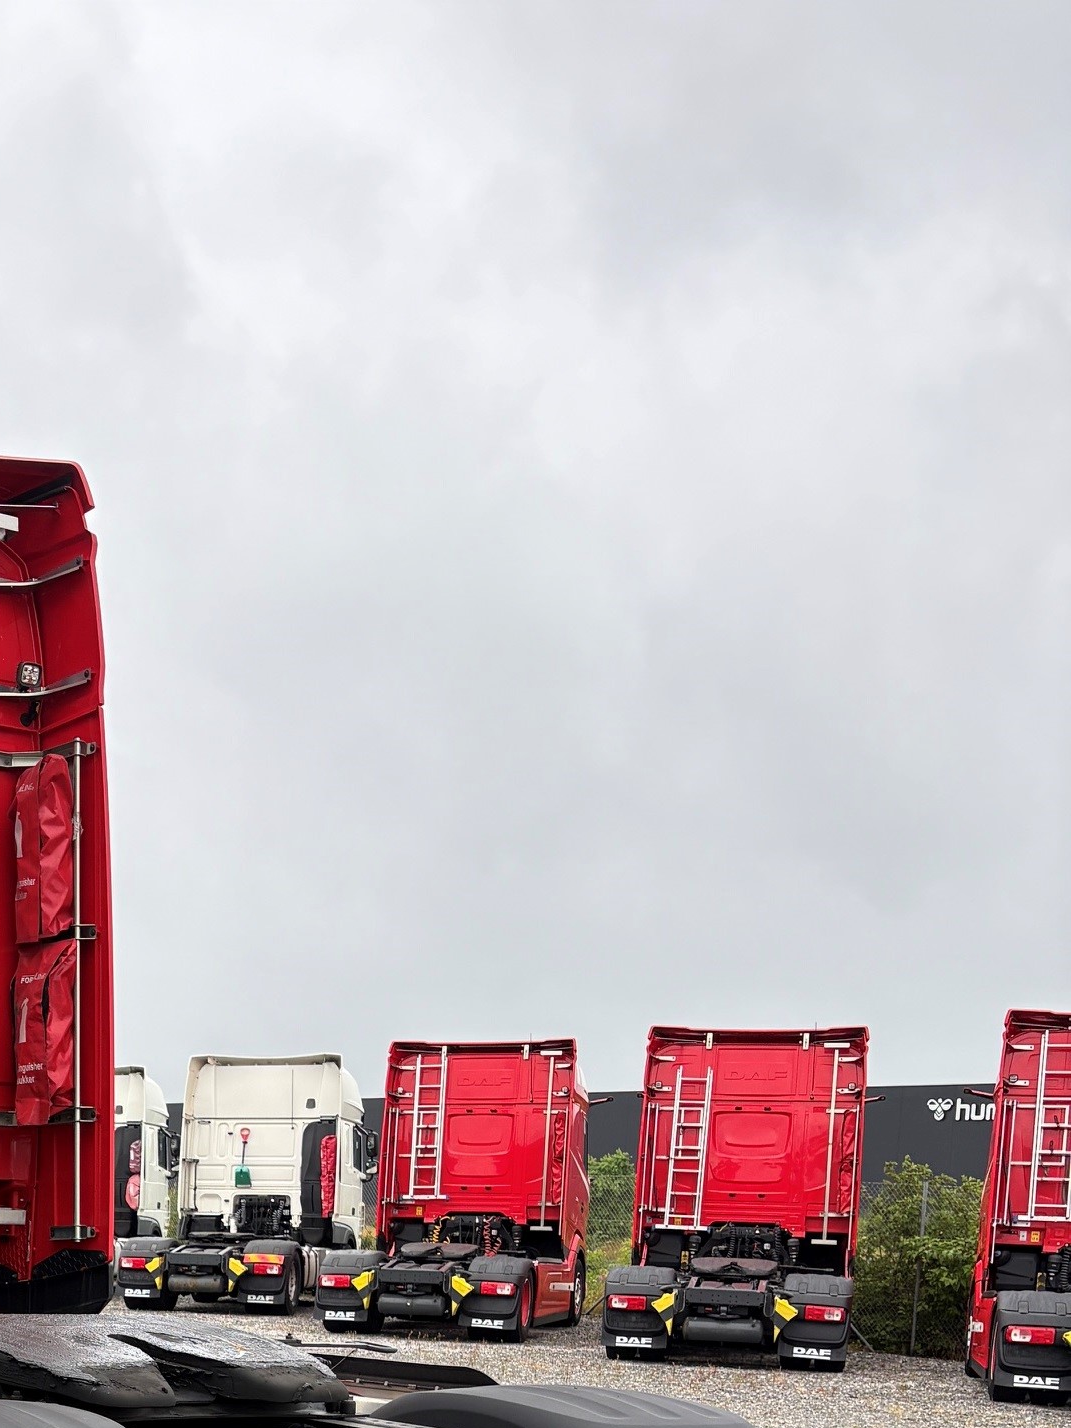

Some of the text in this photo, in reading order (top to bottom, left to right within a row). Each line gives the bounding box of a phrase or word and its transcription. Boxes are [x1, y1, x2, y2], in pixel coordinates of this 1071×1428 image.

[724, 1068, 788, 1081] DAF
[324, 1310, 356, 1318] DAF
[471, 1318, 504, 1327] DAF
[615, 1336, 653, 1344] DAF
[792, 1346, 832, 1356] DAF
[1013, 1374, 1060, 1385] DAF
